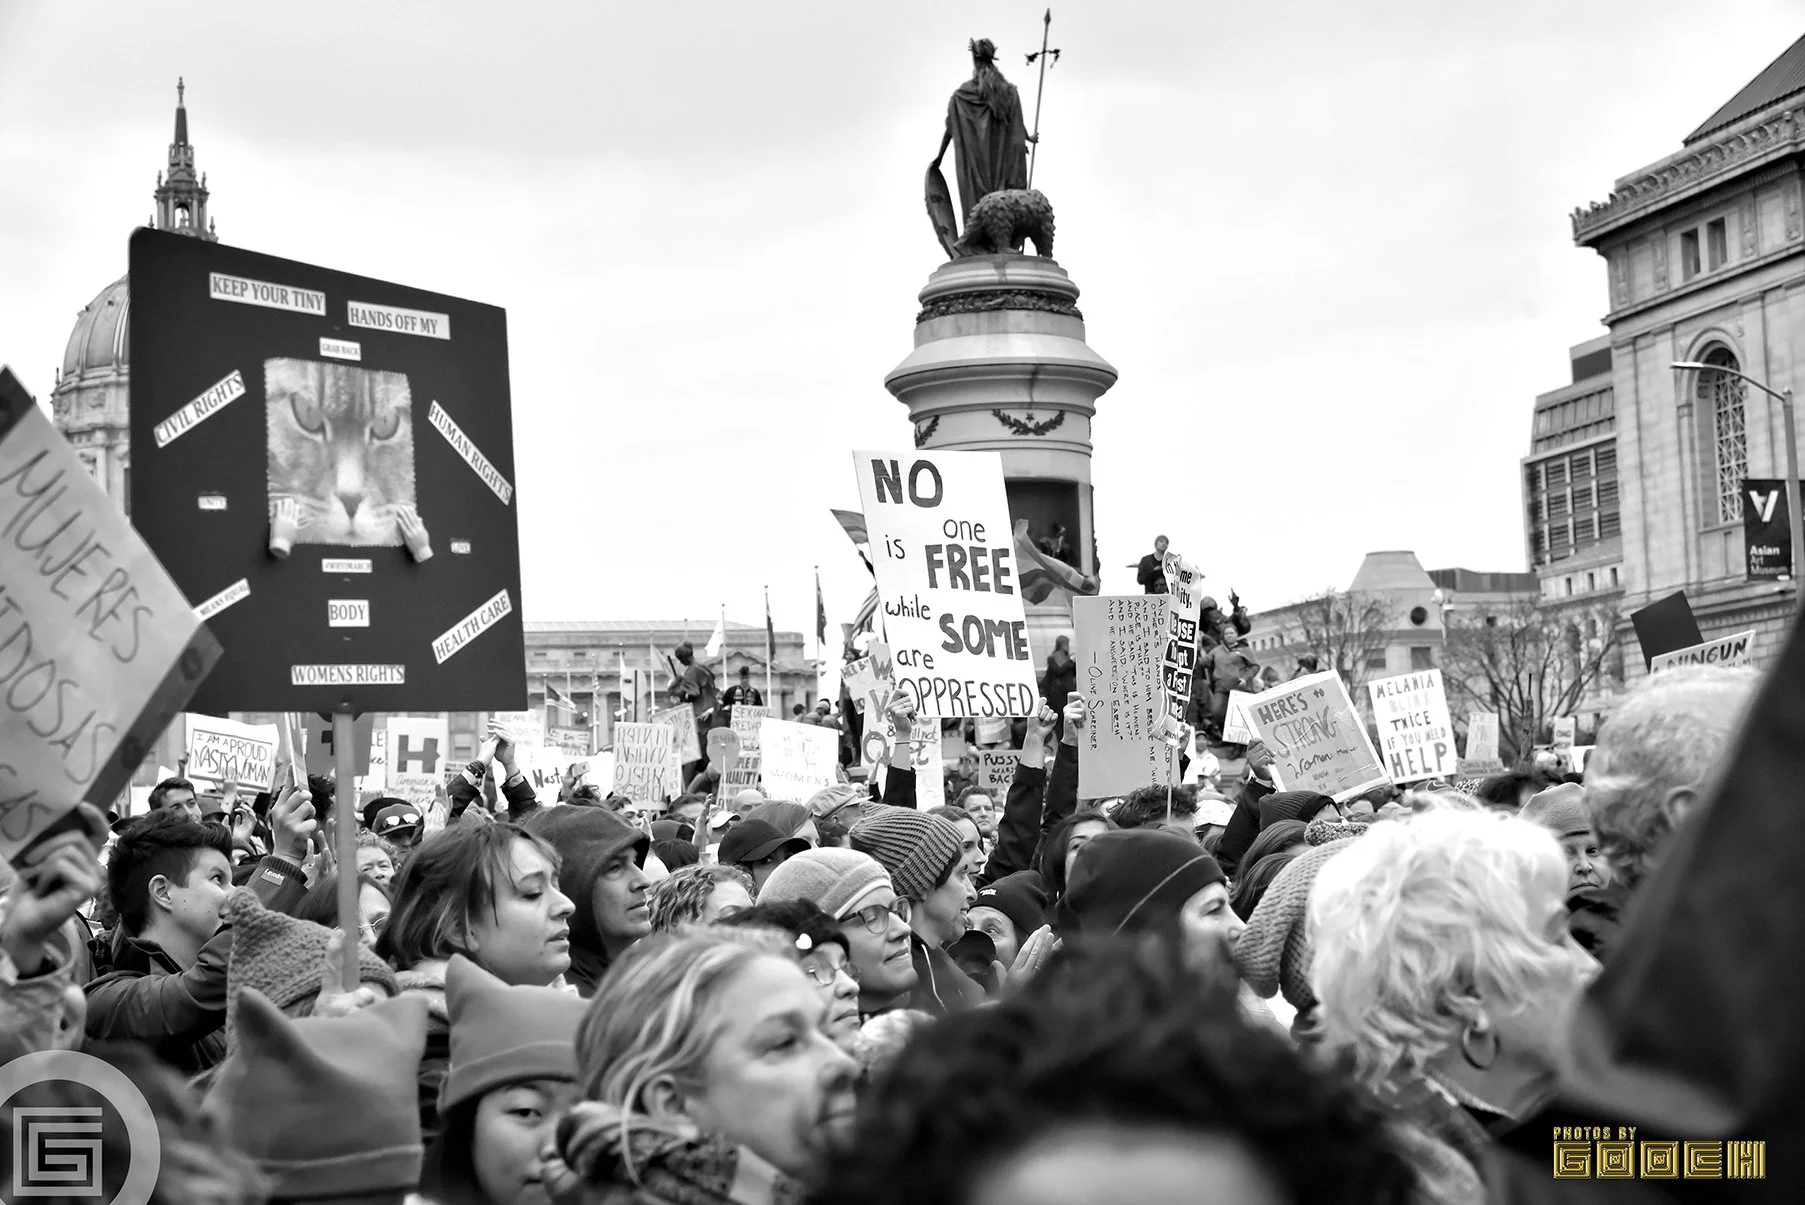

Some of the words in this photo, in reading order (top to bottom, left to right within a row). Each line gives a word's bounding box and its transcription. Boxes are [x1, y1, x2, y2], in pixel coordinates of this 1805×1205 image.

[212, 276, 248, 298] KEEP
[250, 282, 289, 306] YOUR
[292, 290, 324, 311] TINY
[350, 307, 393, 329] HANDS
[395, 314, 417, 332] OFF
[420, 318, 438, 335] MY
[155, 410, 194, 443] CIVIL
[193, 373, 244, 418] RIGHTS
[429, 405, 471, 457] HUMAN
[471, 451, 512, 501] RIGHTS
[871, 459, 943, 508] NO
[943, 519, 986, 542] one
[0, 450, 153, 663] MUJERES
[885, 534, 906, 560] is
[1750, 545, 1780, 555] Asian
[924, 543, 1013, 595] FREE
[329, 604, 366, 620] BODY
[885, 594, 931, 620] while
[435, 618, 480, 660] HEALTH
[480, 594, 510, 626] CARE
[939, 613, 1029, 661] SOME
[1119, 626, 1126, 636] I
[1143, 627, 1150, 638] I
[897, 649, 934, 670] are
[294, 666, 353, 683] WOMENS
[357, 665, 404, 682] RIGHTS
[1145, 667, 1150, 680] TO
[1377, 673, 1434, 699] MELANIA
[898, 677, 1034, 717] OPPRESSED
[1257, 693, 1308, 725] HERE'S
[734, 708, 774, 719] SEXUAL
[1088, 700, 1104, 750] SCHREINER
[1273, 705, 1337, 759] STRONG
[1387, 737, 1396, 750] IF
[1400, 732, 1421, 747] YOU
[207, 735, 219, 744] AM
[230, 739, 267, 761] PROUD
[1390, 742, 1447, 778] HELP
[194, 745, 236, 779] NASTY
[235, 758, 270, 783] WOMAN
[989, 774, 1013, 784] BAC
